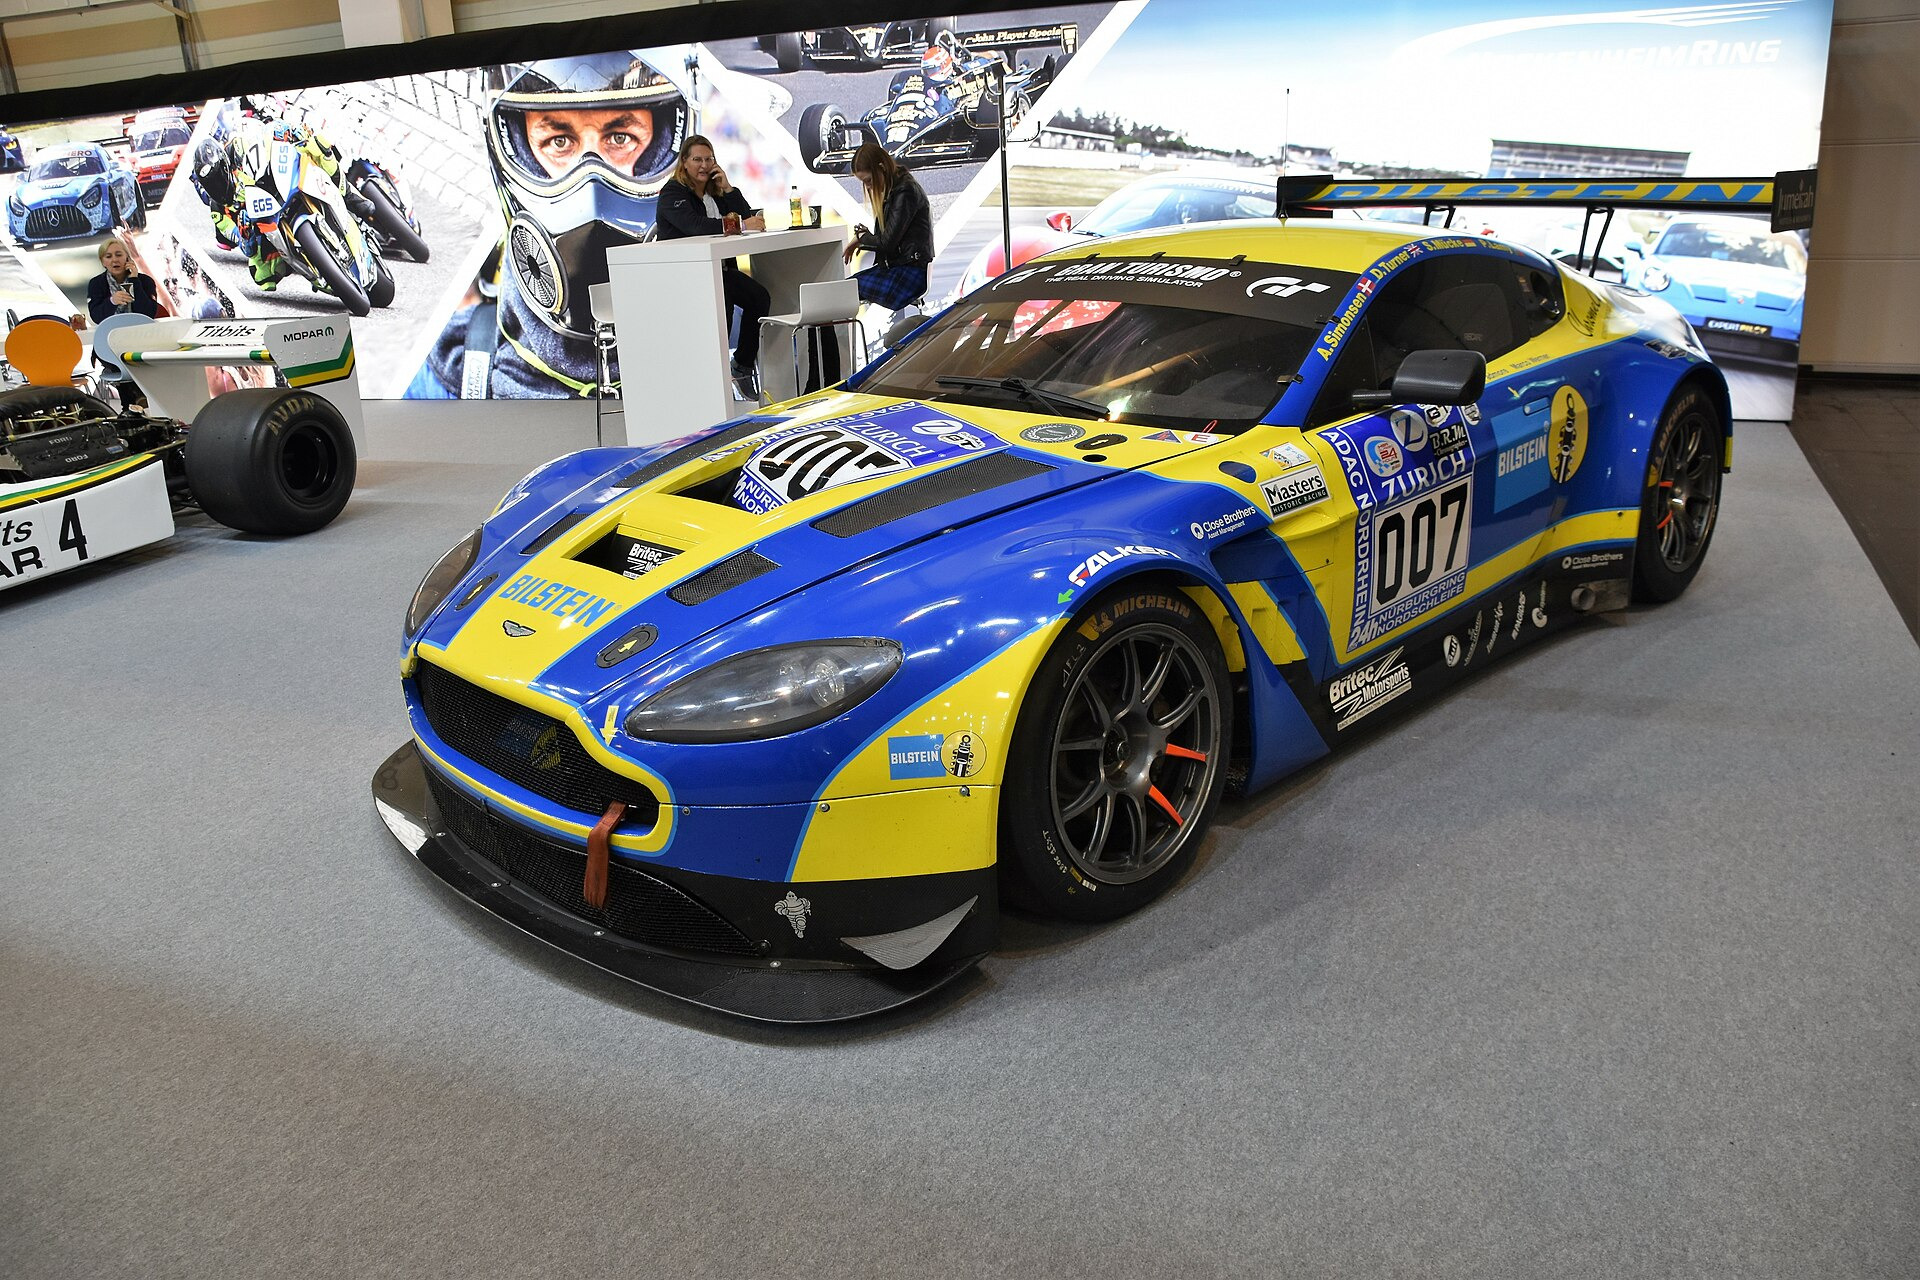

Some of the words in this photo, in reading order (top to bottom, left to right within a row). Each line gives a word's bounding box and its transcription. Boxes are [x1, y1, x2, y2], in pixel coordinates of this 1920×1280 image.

[671, 107, 686, 153] IMPACT
[252, 197, 273, 213] EGS
[1422, 238, 1465, 252] S.Mücke
[1053, 262, 1124, 277] GRAN
[1115, 262, 1231, 282] TURISMO
[1369, 250, 1411, 280] D.Turner
[1136, 276, 1204, 288] SIMULATOR
[196, 325, 256, 338] Titbits
[283, 328, 324, 343] MOPAR
[1316, 291, 1367, 361] A.Simonsen
[847, 420, 935, 458] ZURICH
[1191, 433, 1210, 443] E
[1498, 434, 1548, 478] BILSTEIN
[1264, 475, 1323, 505] Masters
[1381, 450, 1467, 507] ZURICH
[1273, 498, 1303, 513] HISTORIC
[1303, 489, 1327, 502] RACING
[58, 498, 89, 562] 4
[1202, 518, 1224, 533] Close
[1224, 505, 1257, 525] Brothers
[1321, 431, 1364, 489] ADAC
[1353, 493, 1373, 628] NORDRHEIN
[628, 543, 663, 562] Britec
[1376, 482, 1469, 605] 007
[498, 574, 616, 628] BILSTEIN
[1113, 594, 1191, 619] MICHELIN
[1379, 571, 1466, 625] NÜRBURGRING
[1350, 616, 1379, 649] 24h
[1376, 582, 1465, 637] NORDSCHLEIFE
[1329, 664, 1375, 704] Britec
[1362, 666, 1411, 703] Motorsports
[890, 750, 939, 765] BILSTEIN
